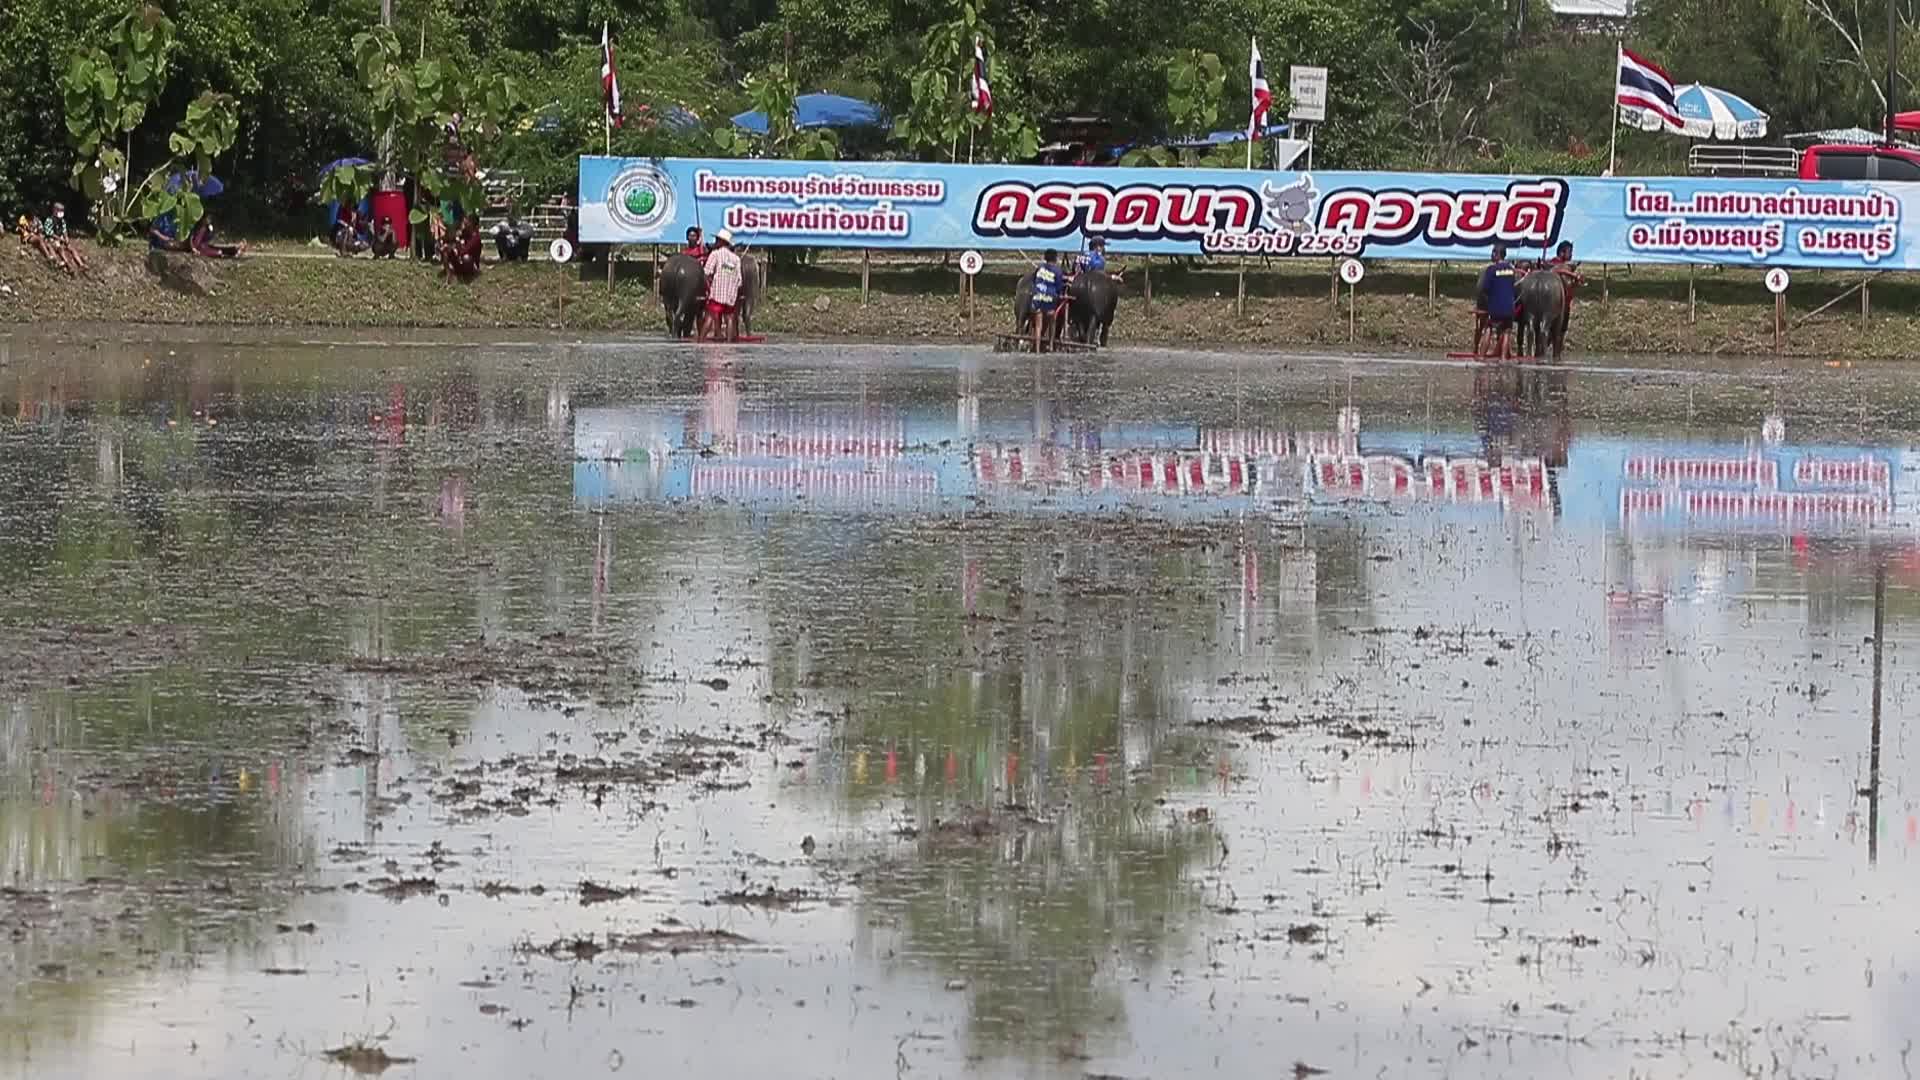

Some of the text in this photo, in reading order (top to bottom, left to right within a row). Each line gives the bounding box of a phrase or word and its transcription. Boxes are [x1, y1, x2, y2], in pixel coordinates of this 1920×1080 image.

[697, 172, 941, 201] โครงการอนุรักษ์วัฒนธรรม
[726, 205, 906, 232] ประเพณีท้องถิ่น
[982, 188, 1555, 234] คราดนา ควายดี
[1206, 232, 1360, 251] ประจำปี 2565
[1632, 222, 1892, 255] อ.เมืองชลบุรี จ.ชลบุรี
[967, 256, 976, 269] 2
[1347, 265, 1357, 278] 3
[1769, 272, 1780, 287] 4
